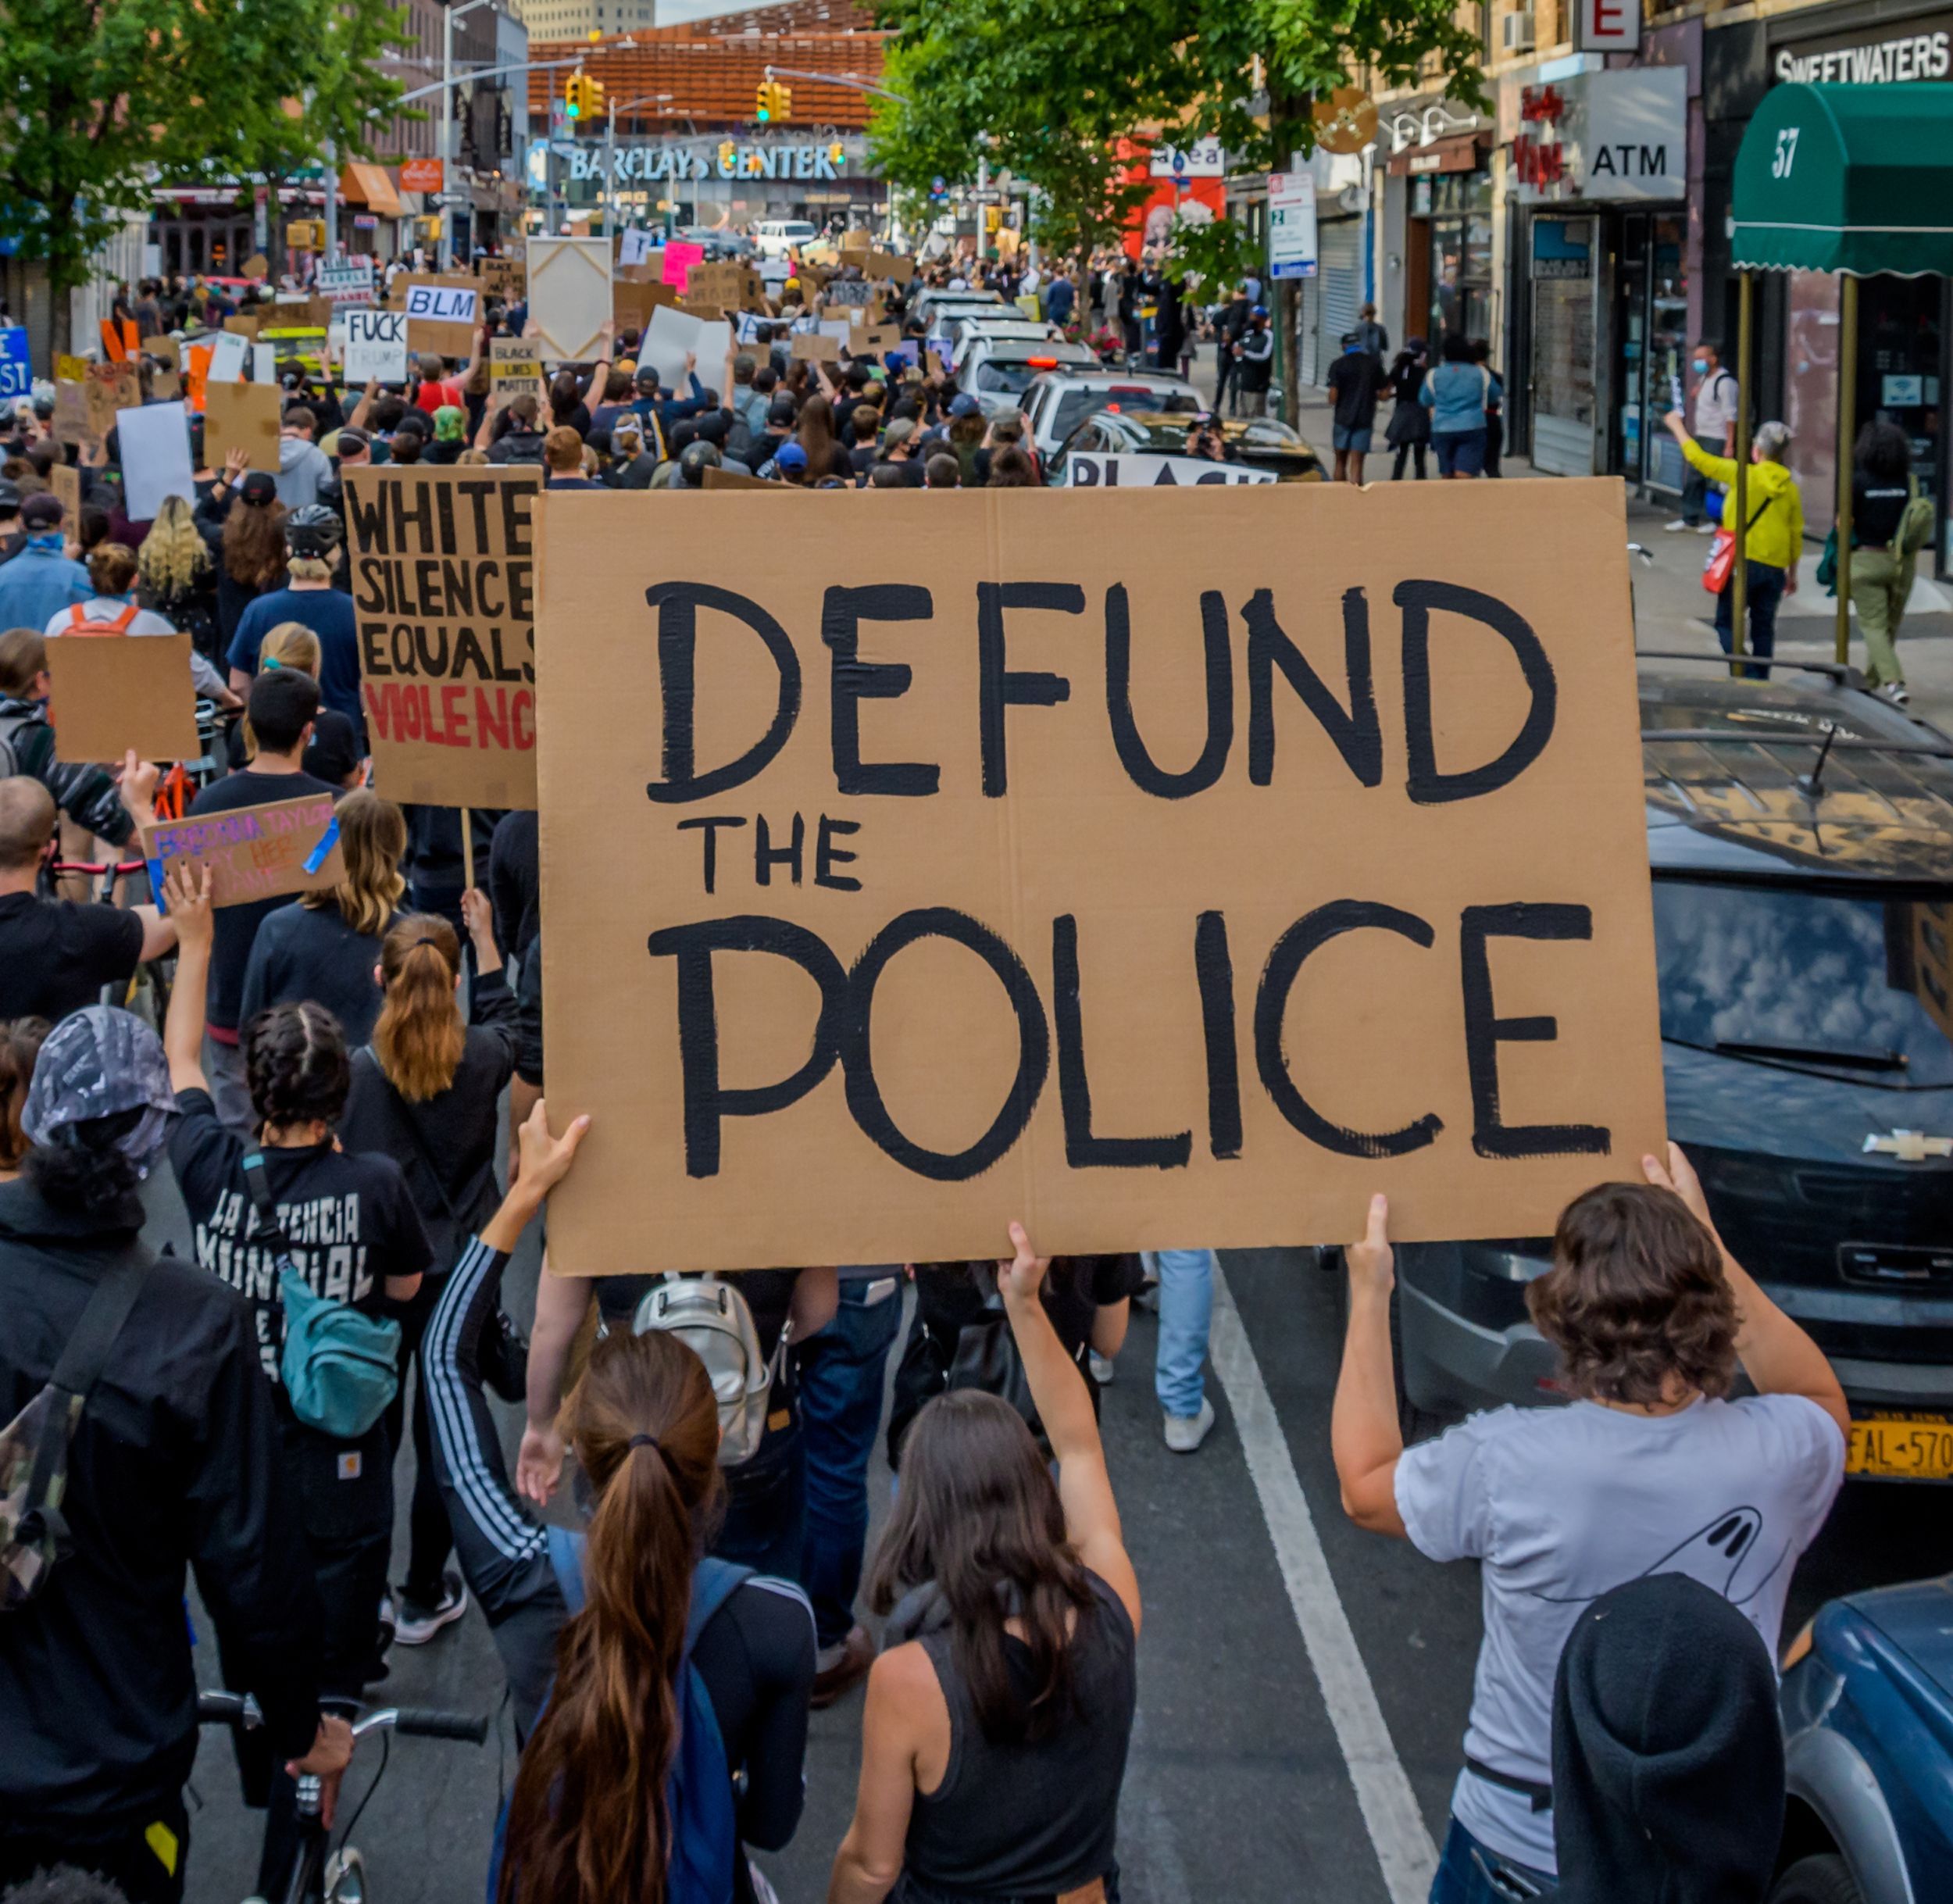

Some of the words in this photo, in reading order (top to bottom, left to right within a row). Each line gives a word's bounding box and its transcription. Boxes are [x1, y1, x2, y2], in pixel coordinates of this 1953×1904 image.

[1591, 144, 1666, 177] ATM
[1772, 127, 1800, 179] 57
[409, 290, 473, 316] BLM
[350, 313, 404, 342] FUCK
[350, 348, 403, 366] TRUMP
[495, 347, 534, 359] BLACK
[497, 380, 539, 391] MATTER
[345, 480, 539, 555] WHITE
[356, 558, 533, 622] SILENCE
[646, 580, 1557, 804] DEFUND
[249, 834, 295, 869] HER
[677, 812, 863, 894] THE
[648, 899, 1611, 1181] POLICE
